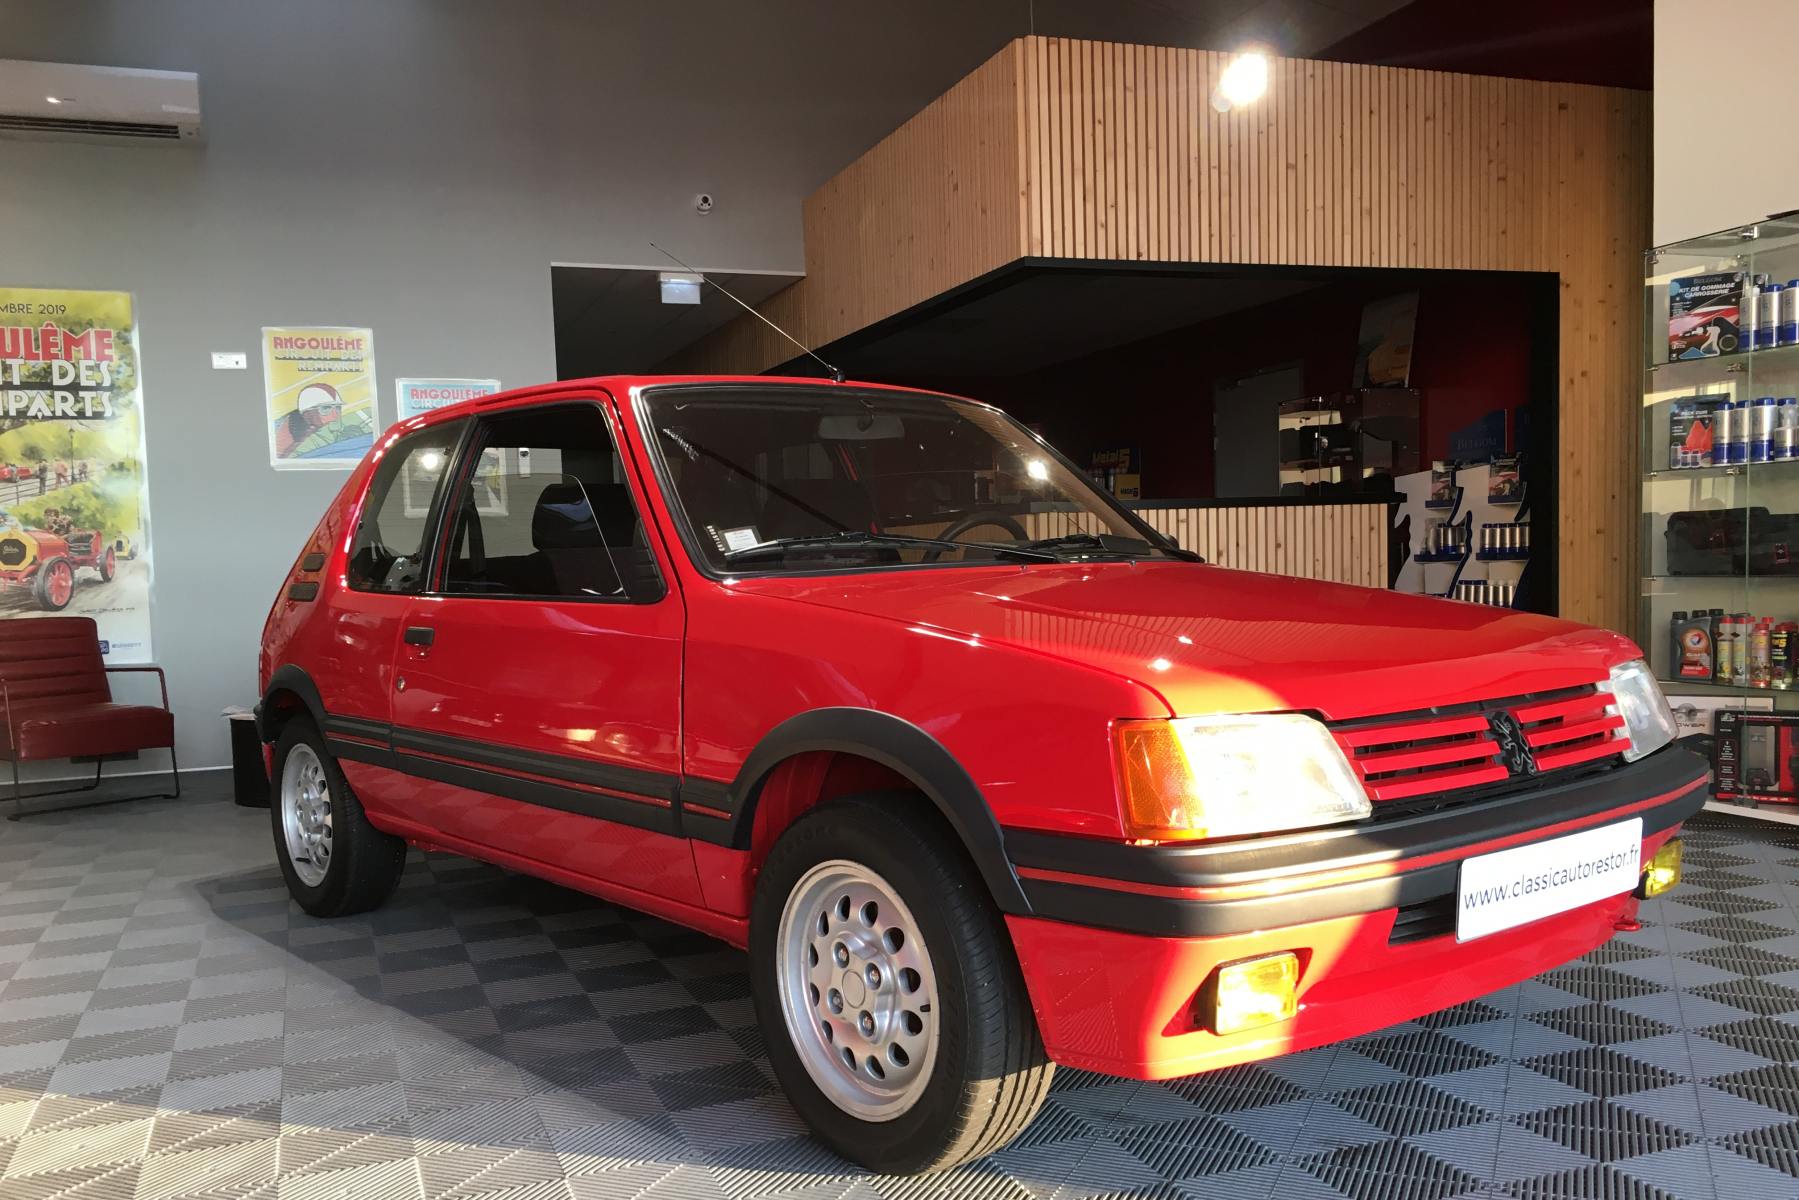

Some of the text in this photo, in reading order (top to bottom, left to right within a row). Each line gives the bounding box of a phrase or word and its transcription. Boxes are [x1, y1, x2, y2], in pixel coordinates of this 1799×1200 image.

[39, 304, 67, 315] 2019
[0, 359, 112, 387] T DES
[1464, 844, 1638, 909] www.classicautorestor.fr
